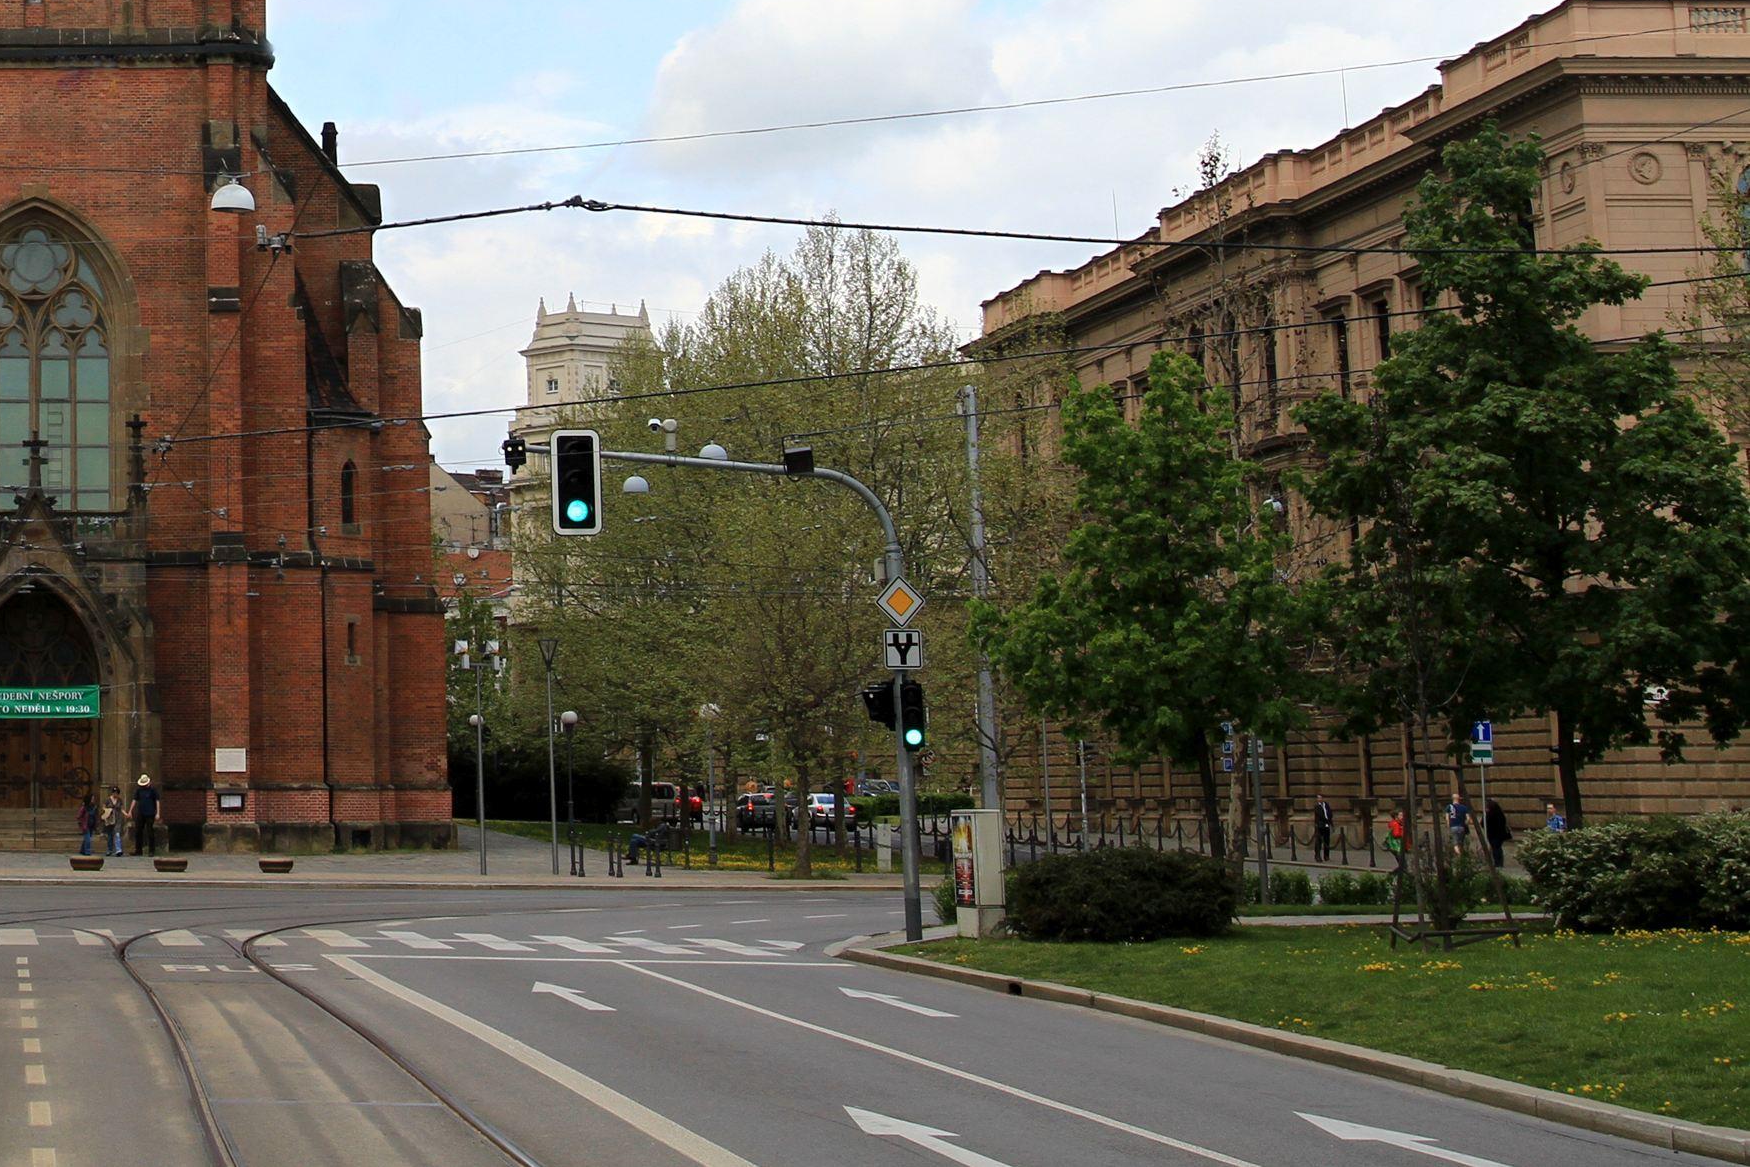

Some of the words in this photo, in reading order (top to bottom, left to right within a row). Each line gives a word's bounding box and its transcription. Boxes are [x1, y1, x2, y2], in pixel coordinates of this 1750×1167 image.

[39, 690, 84, 701] NEŠPORY
[14, 704, 50, 714] NEDĚLI
[66, 705, 90, 714] 19:30
[160, 964, 319, 973] BUS
